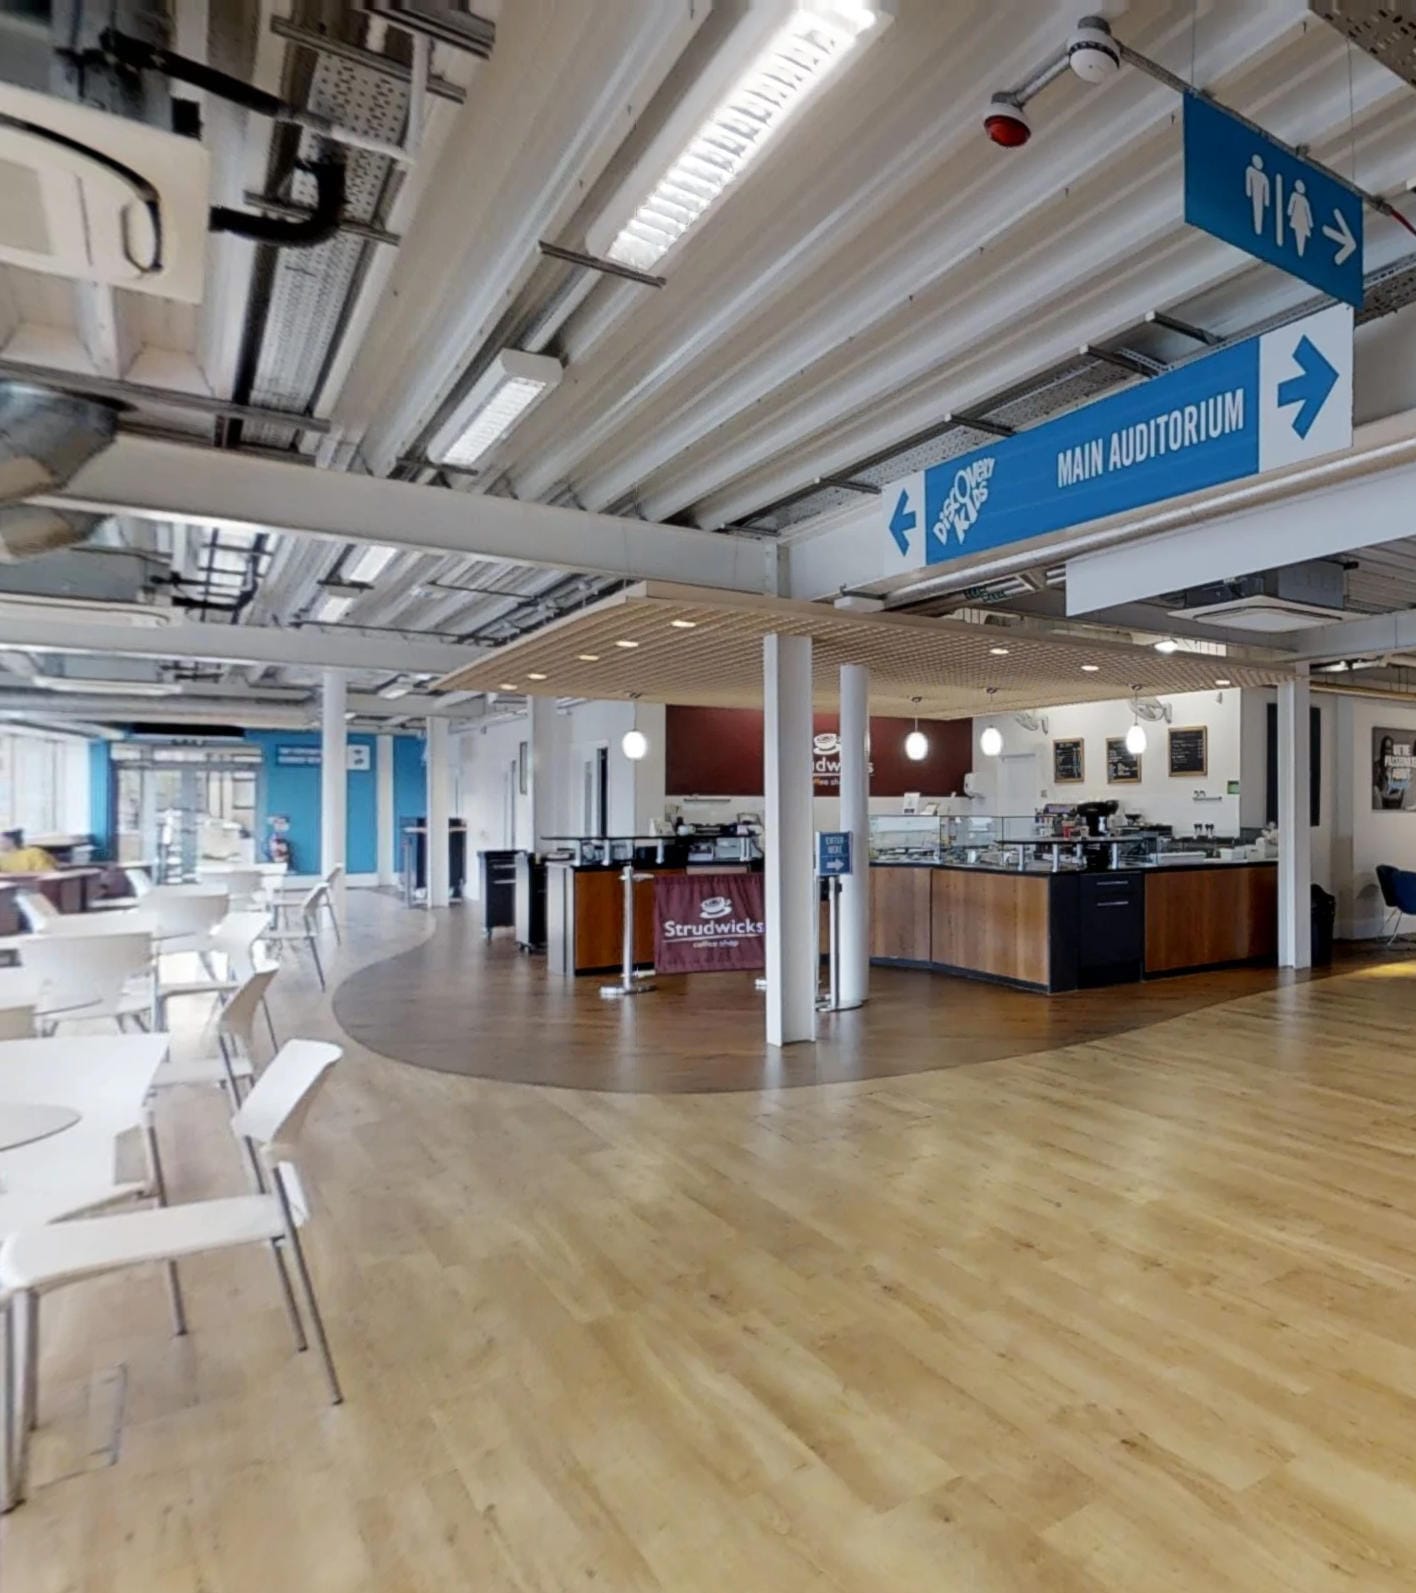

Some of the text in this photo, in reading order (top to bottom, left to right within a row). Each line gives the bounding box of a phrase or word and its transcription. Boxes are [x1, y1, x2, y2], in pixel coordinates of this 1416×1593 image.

[1057, 388, 1244, 488] MAIN AUDITORIUM
[664, 918, 766, 937] Strudwicks
